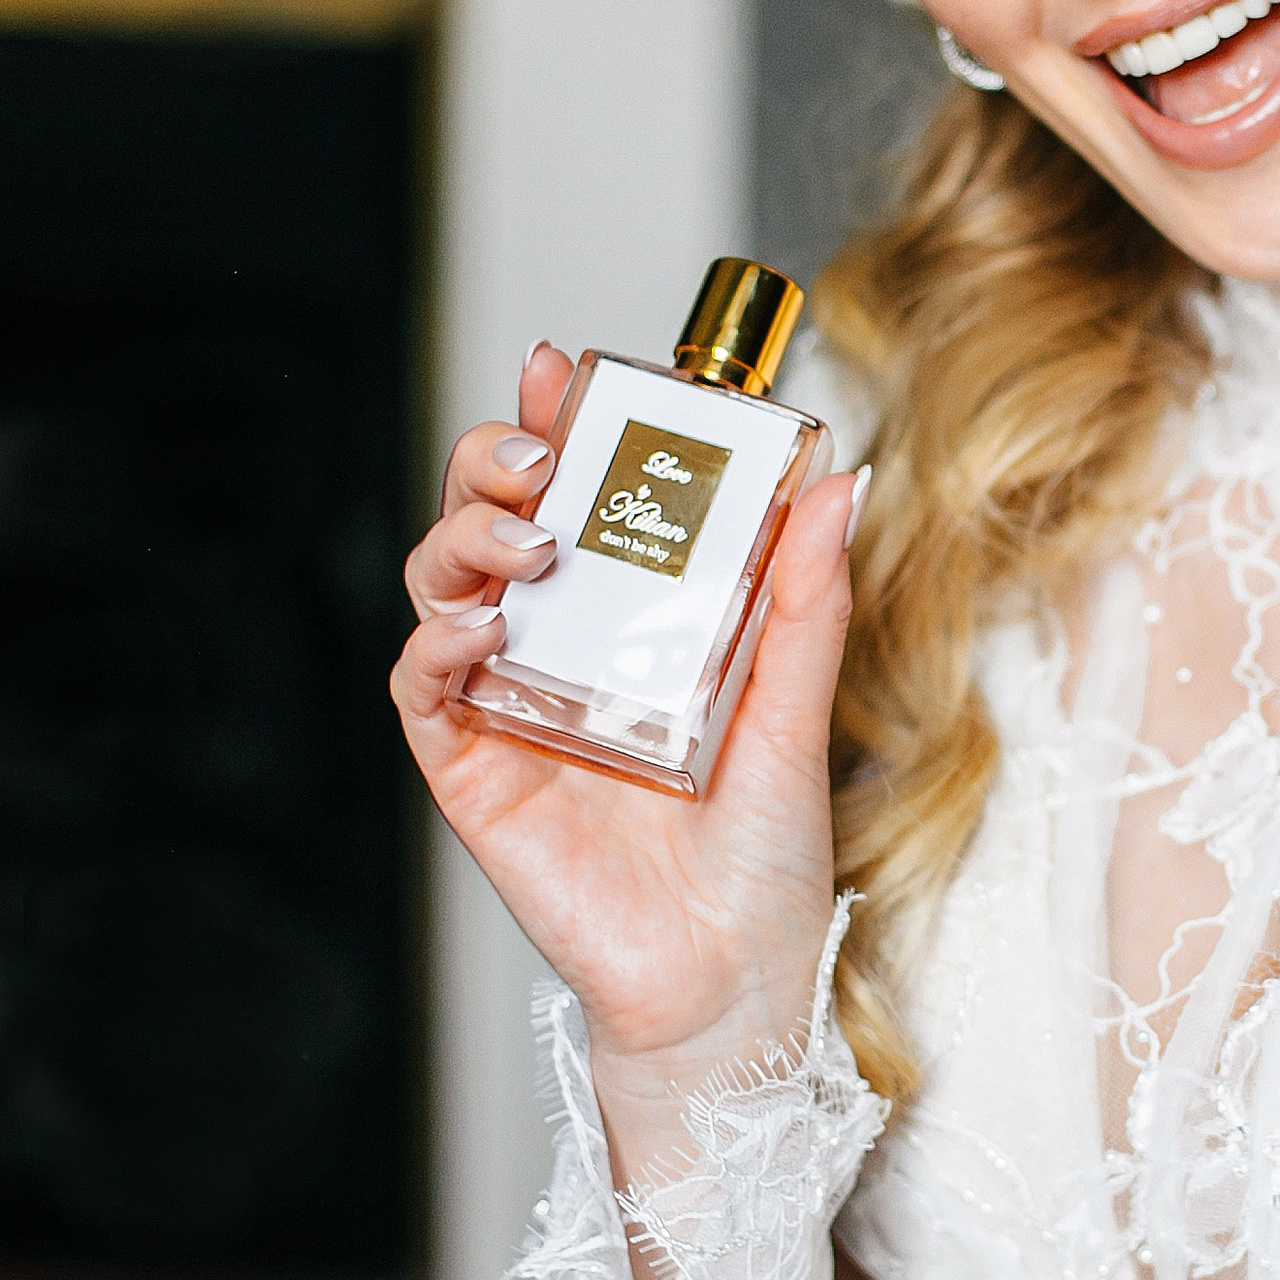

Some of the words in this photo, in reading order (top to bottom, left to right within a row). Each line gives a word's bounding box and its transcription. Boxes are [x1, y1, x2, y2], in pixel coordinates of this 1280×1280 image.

[641, 451, 692, 484] Love
[599, 490, 688, 543] Kilian
[600, 530, 631, 550] don't
[630, 538, 647, 554] be
